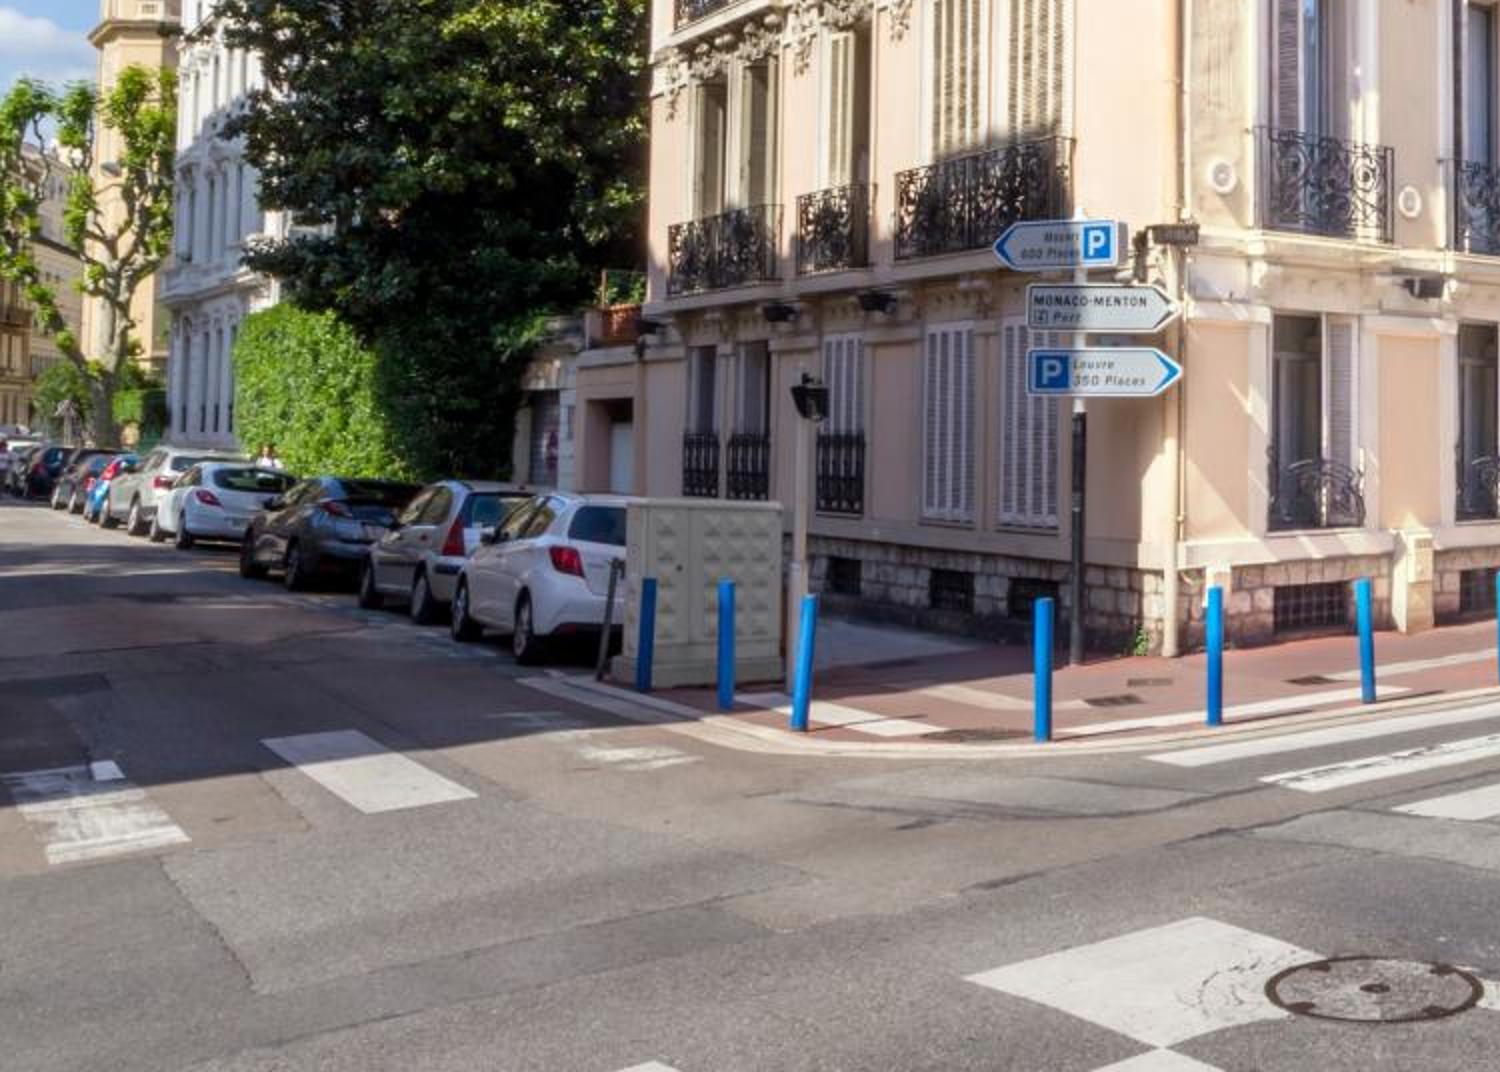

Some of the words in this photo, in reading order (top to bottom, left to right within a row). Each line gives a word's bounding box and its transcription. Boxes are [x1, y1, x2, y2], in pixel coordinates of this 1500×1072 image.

[1088, 230, 1105, 256] P
[1033, 295, 1147, 307] MONACO-MENTON
[1074, 359, 1115, 369] Louvre
[1042, 359, 1063, 384] P
[1073, 375, 1100, 386] 350
[1105, 375, 1146, 386] Places
